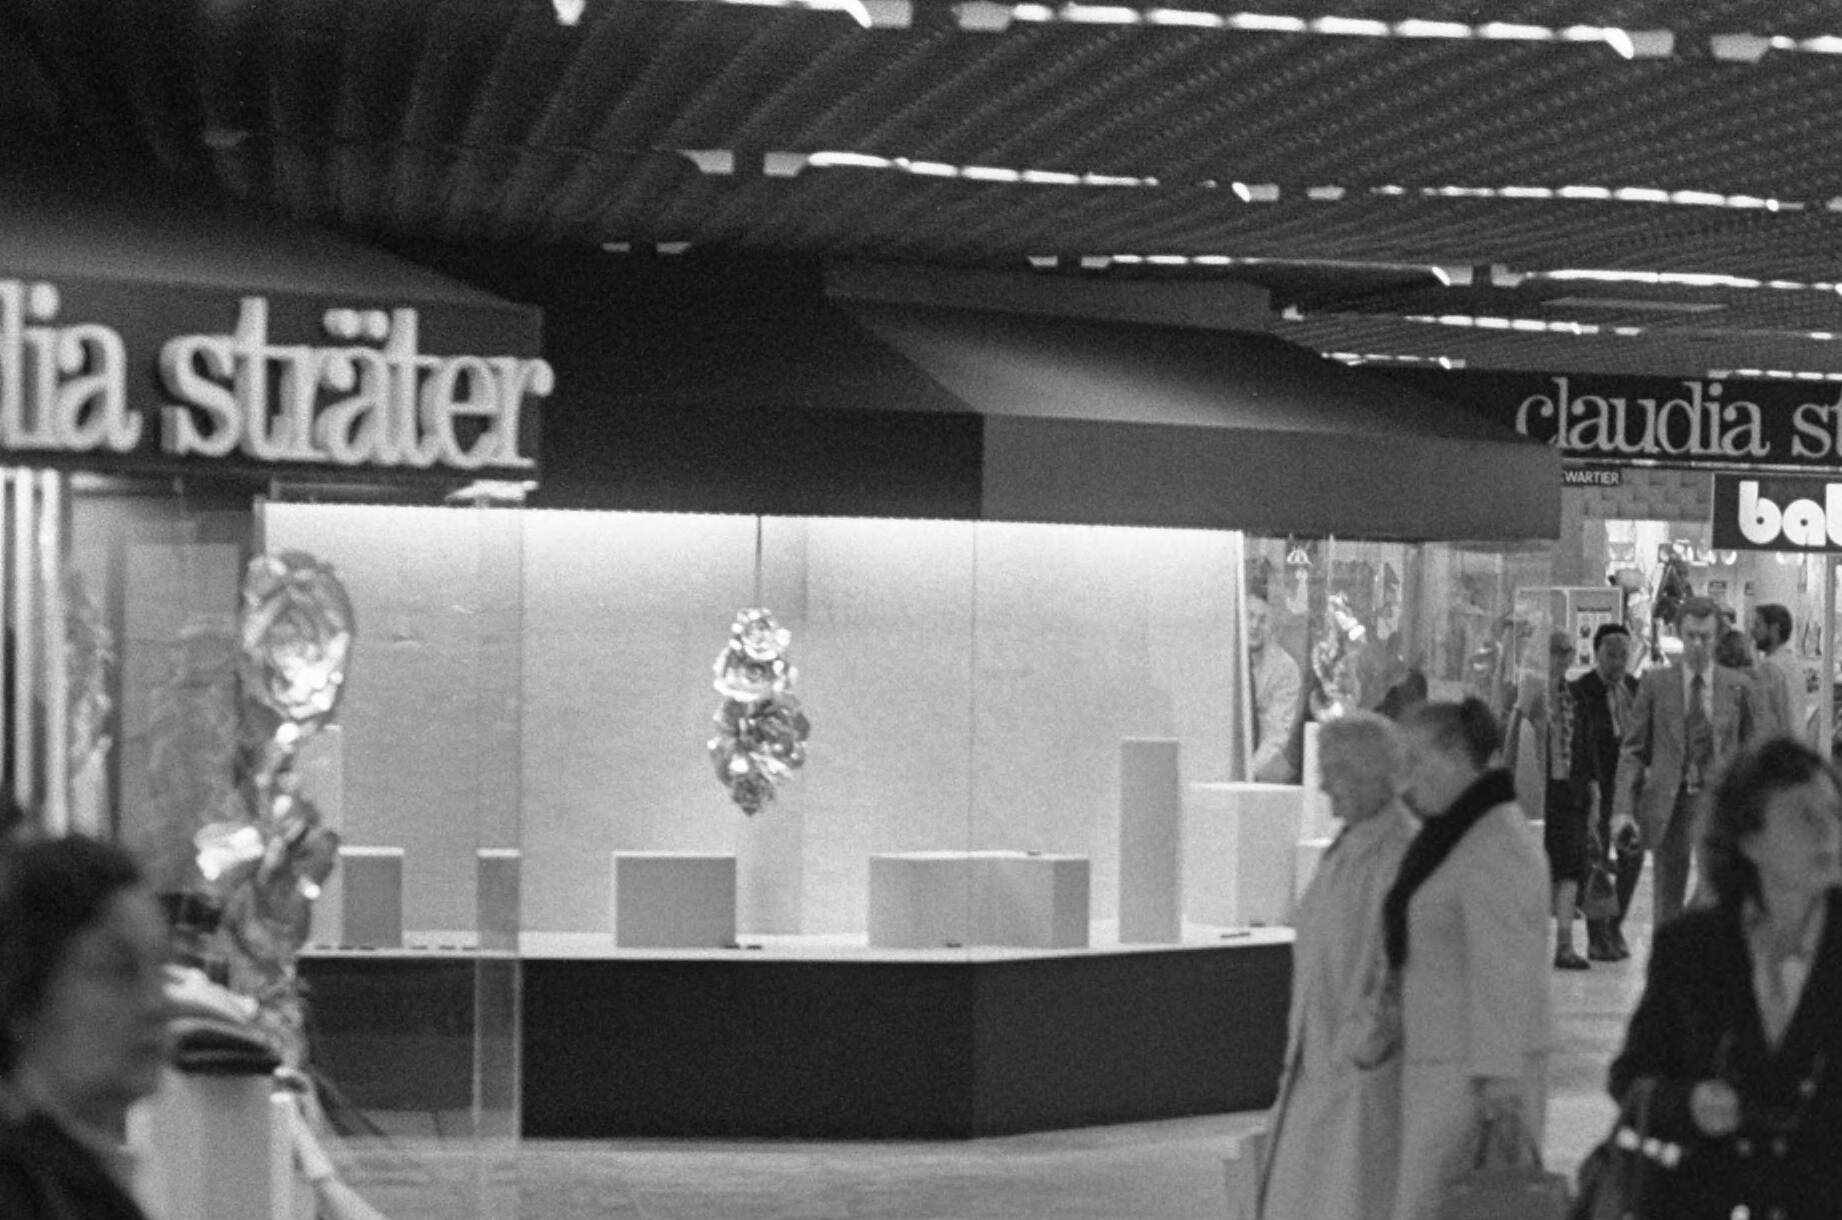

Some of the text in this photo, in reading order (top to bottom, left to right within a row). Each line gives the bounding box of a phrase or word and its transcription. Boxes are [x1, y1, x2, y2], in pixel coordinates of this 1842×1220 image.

[159, 297, 555, 469] sträter
[1515, 376, 1771, 457] claudia
[1561, 470, 1619, 485] WARTIER
